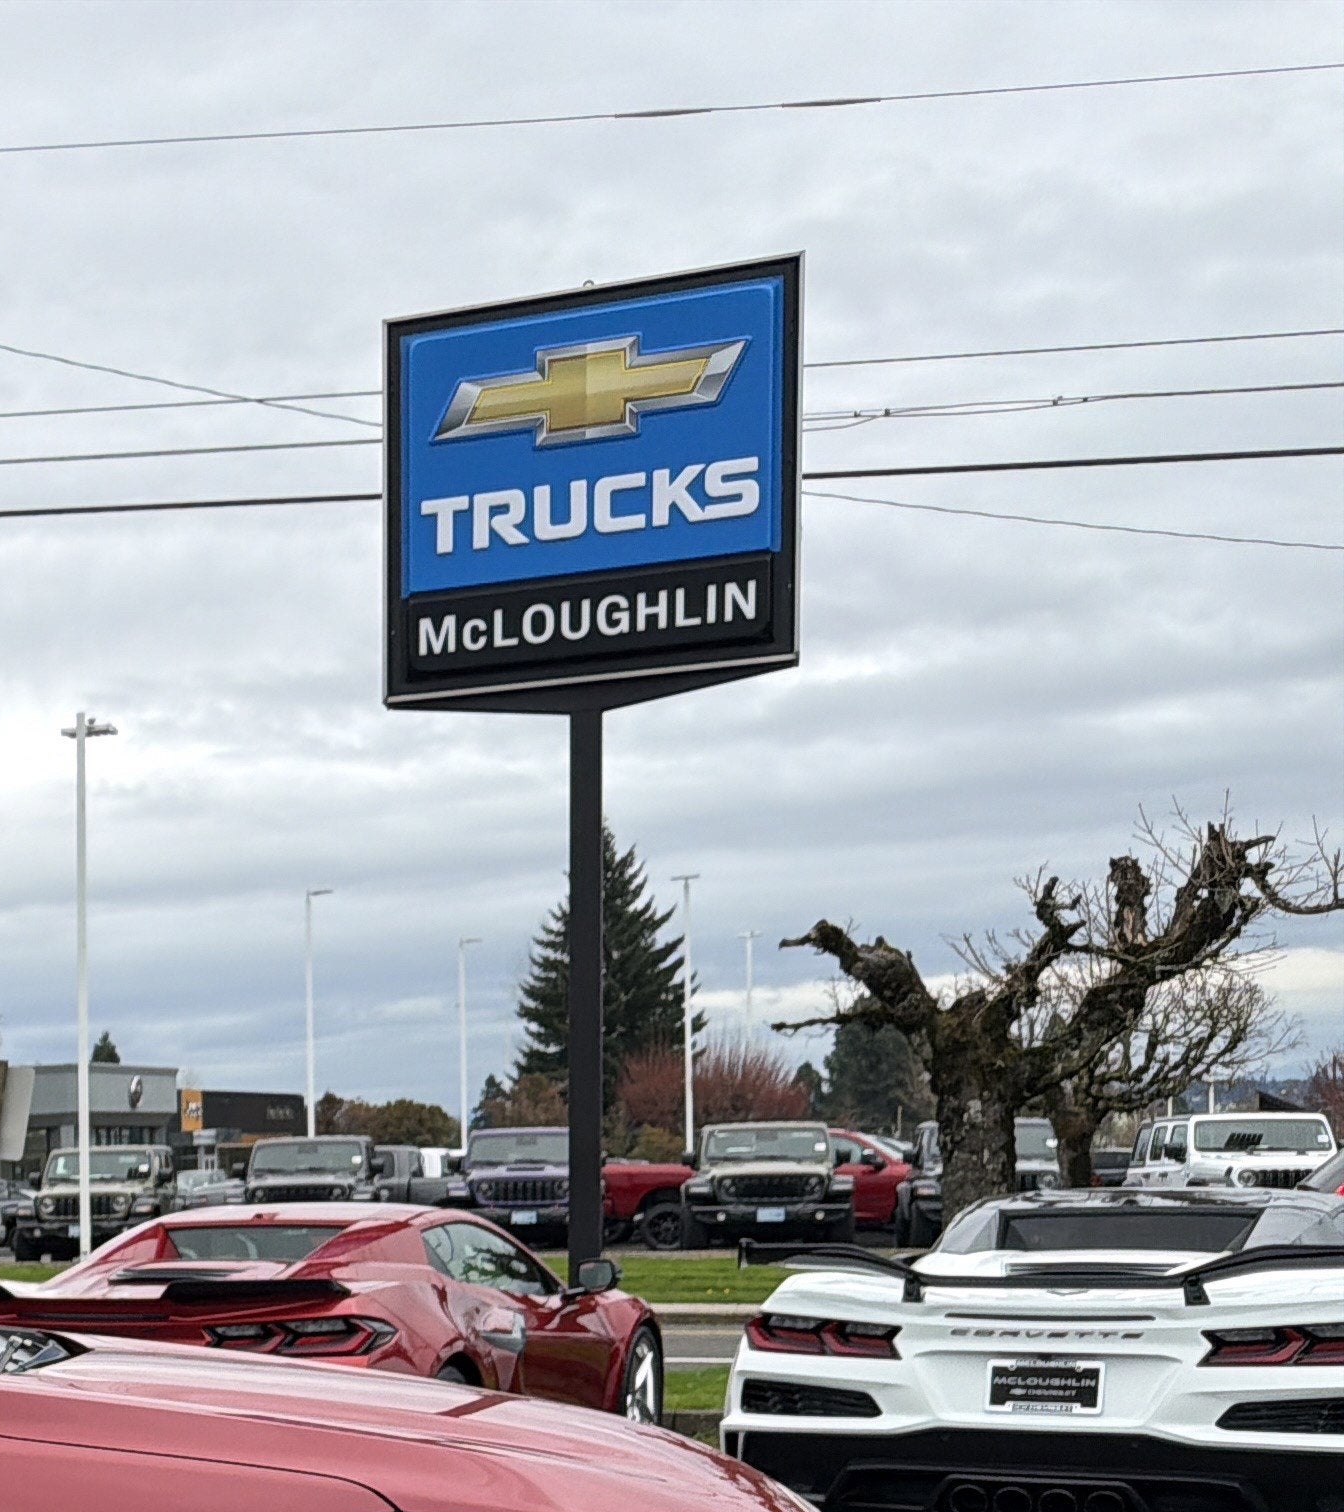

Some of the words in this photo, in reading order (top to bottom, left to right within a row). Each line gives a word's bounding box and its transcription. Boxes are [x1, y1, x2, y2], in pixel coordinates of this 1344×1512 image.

[420, 456, 760, 555] TRUCKS
[418, 579, 758, 656] McLOUGHLIN
[951, 1328, 1145, 1339] CORVETTE
